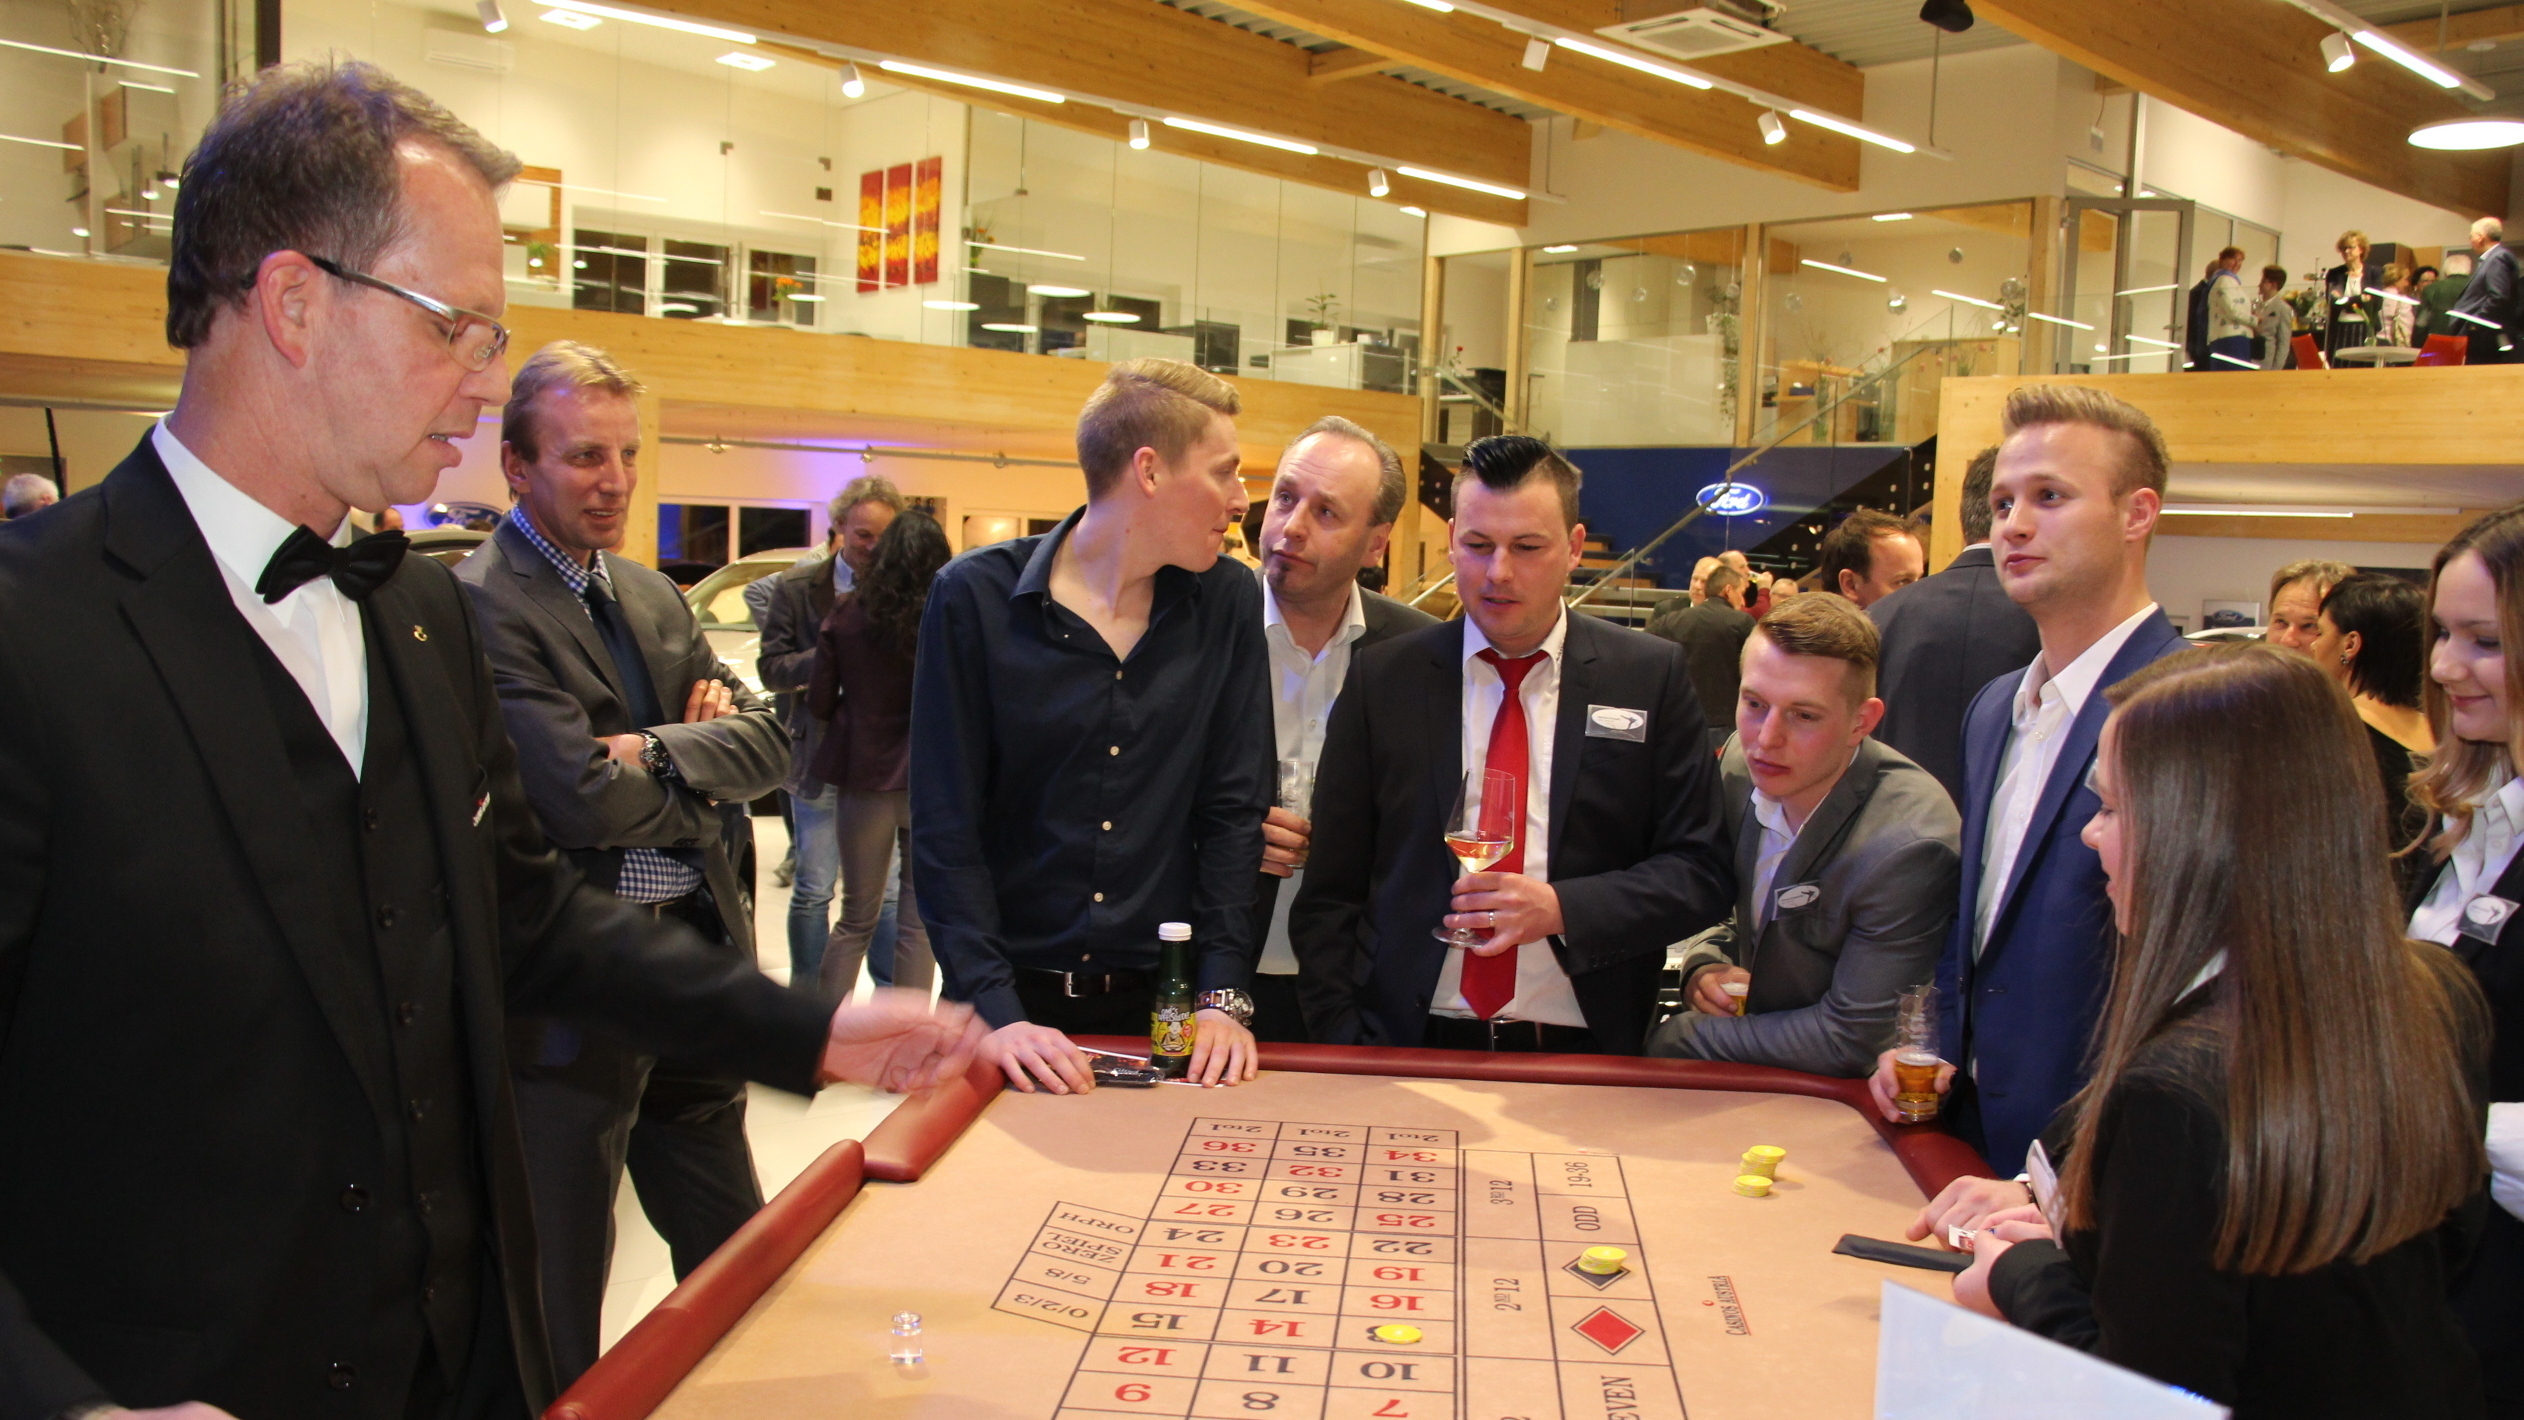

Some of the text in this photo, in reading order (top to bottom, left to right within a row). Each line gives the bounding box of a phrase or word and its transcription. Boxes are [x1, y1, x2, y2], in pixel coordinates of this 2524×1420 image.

[1203, 1141, 1256, 1153] 36
[1293, 1146, 1346, 1158] 35
[1384, 1150, 1438, 1162] 34
[1193, 1160, 1248, 1173] 33
[1289, 1165, 1344, 1178] 32
[1564, 1161, 1592, 1188] 19-36
[1384, 1170, 1436, 1183] 31
[1185, 1180, 1243, 1194] 30
[1280, 1186, 1339, 1199] 29
[1377, 1191, 1436, 1205] 28
[1174, 1202, 1236, 1217] 27
[1274, 1208, 1334, 1223] 26
[1059, 1212, 1135, 1234] ORPH
[1376, 1214, 1435, 1228] 25
[1572, 1205, 1601, 1232] ODD
[1046, 1232, 1123, 1255] SPIEL
[1163, 1227, 1225, 1243] 24
[1268, 1234, 1331, 1250] 23
[1042, 1241, 1117, 1263] ZERO
[1372, 1239, 1433, 1255] 22
[1156, 1253, 1218, 1270] 21
[1259, 1260, 1324, 1276] 20
[1045, 1268, 1091, 1285] 5/8
[1373, 1266, 1426, 1282] 19
[1144, 1281, 1201, 1298] 18
[1255, 1288, 1311, 1305] 17
[1013, 1292, 1089, 1319] 0/2/3
[1369, 1294, 1425, 1311] 16
[1707, 1275, 1747, 1335] CASINOS AUSTRIA
[1131, 1312, 1189, 1330] 15
[1249, 1318, 1306, 1338] 14
[1117, 1346, 1178, 1366] 12
[1243, 1354, 1297, 1374] 11
[1360, 1361, 1419, 1381] 10
[1114, 1383, 1152, 1403] 9
[1241, 1391, 1279, 1411] 8
[1600, 1375, 1640, 1420] EVEN
[1372, 1398, 1409, 1418] 7
